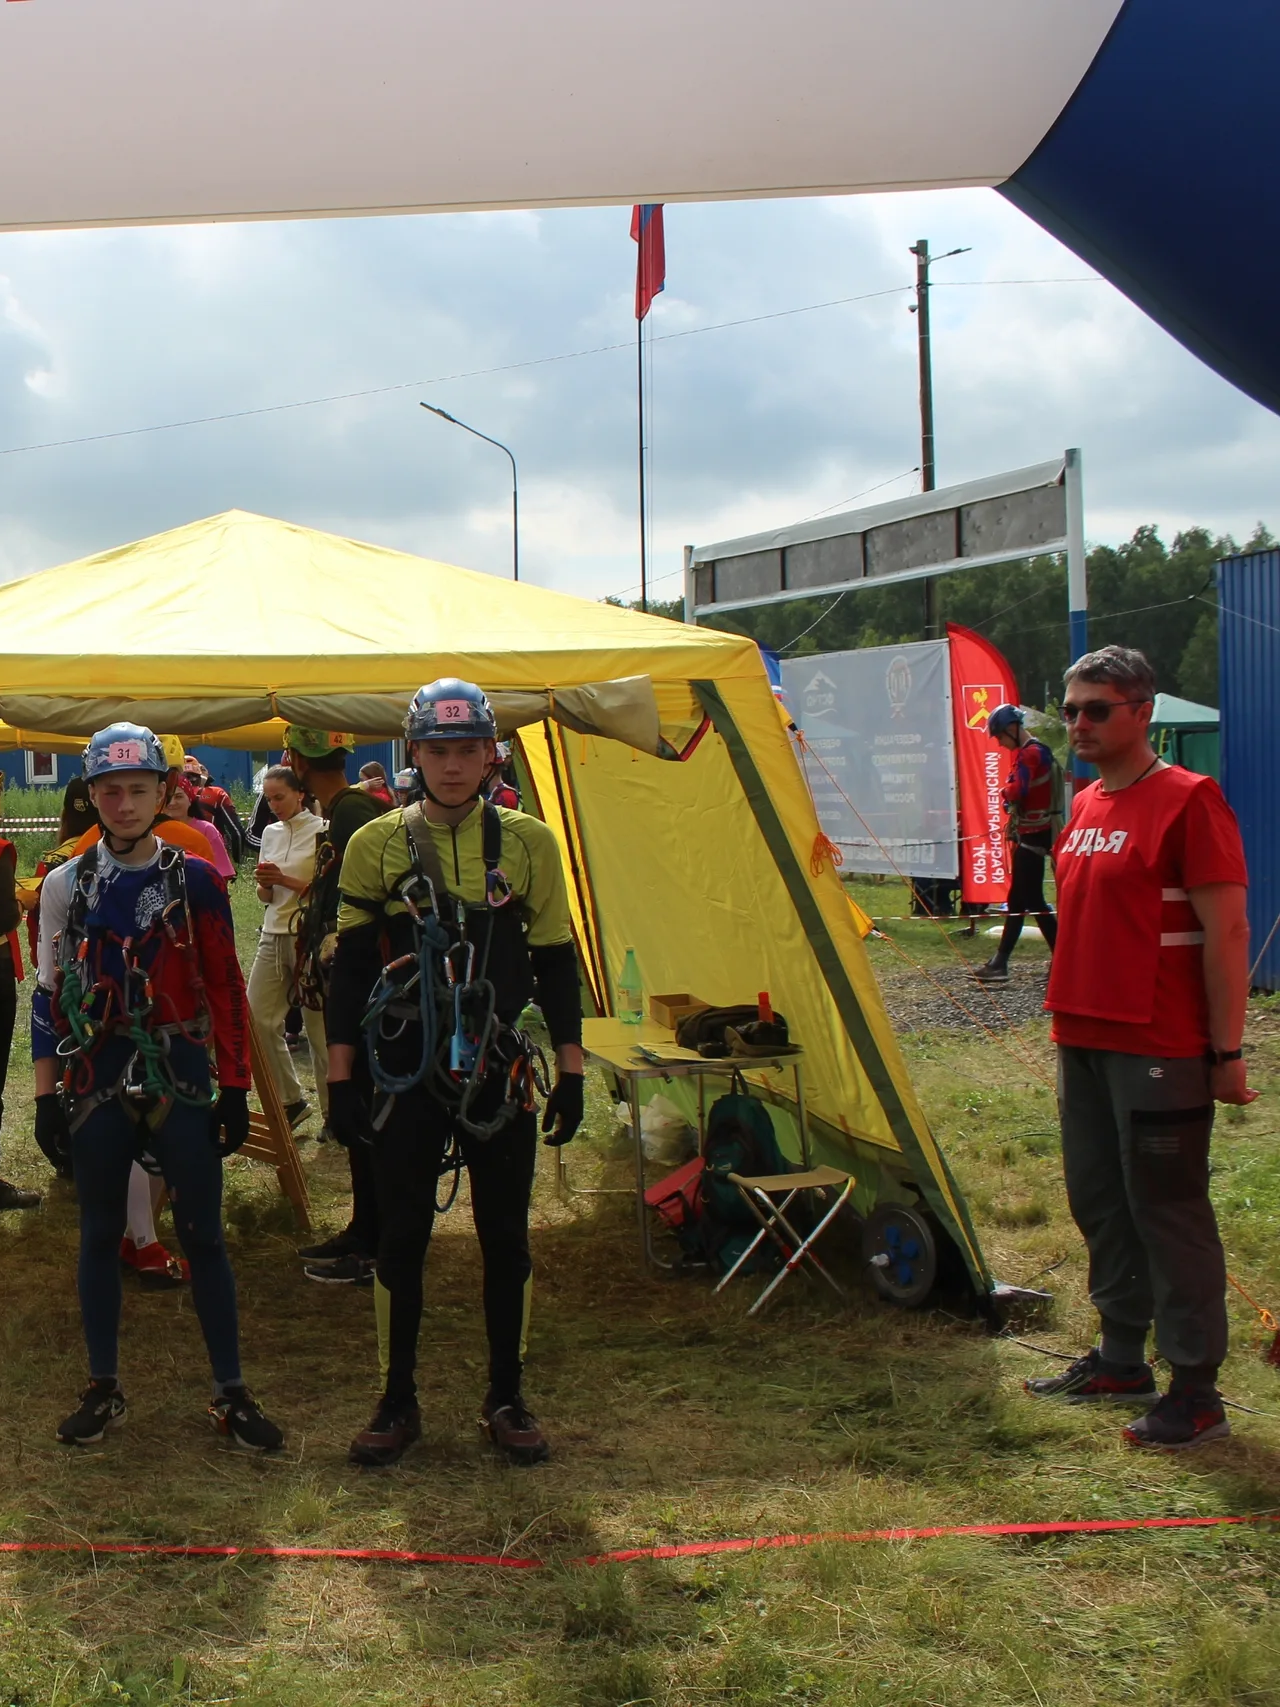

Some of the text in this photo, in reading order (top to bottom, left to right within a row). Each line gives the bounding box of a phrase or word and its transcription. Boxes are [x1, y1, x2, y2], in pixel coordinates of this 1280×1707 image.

[445, 706, 461, 718] 32
[333, 734, 343, 744] 42
[117, 748, 131, 759] 31
